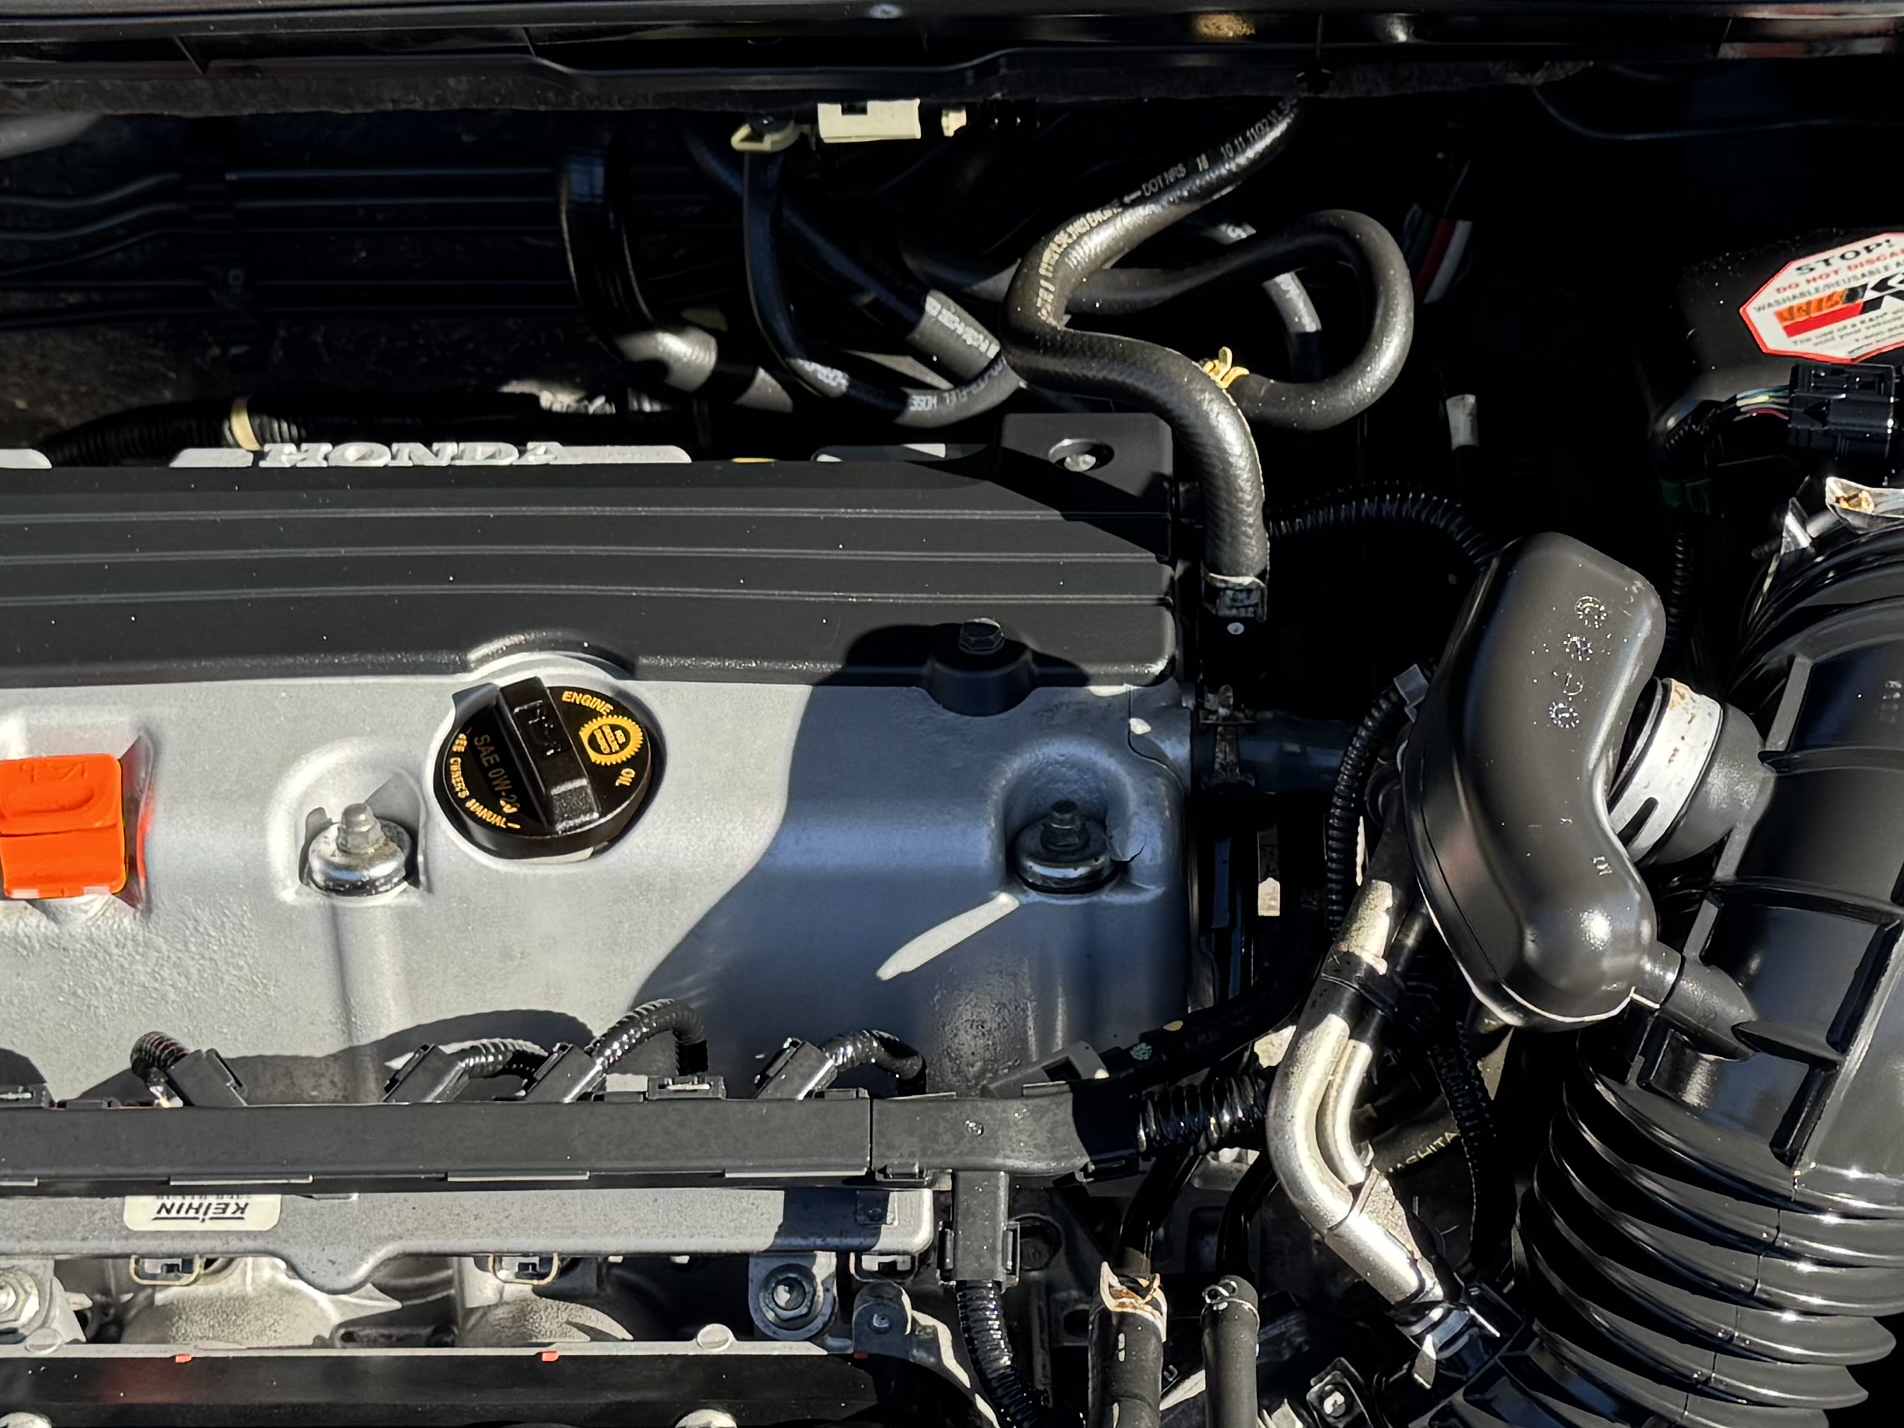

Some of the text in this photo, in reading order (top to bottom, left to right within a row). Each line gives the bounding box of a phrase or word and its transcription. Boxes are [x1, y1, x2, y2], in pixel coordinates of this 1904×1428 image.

[1795, 236, 1894, 277] STOP!
[1754, 264, 1890, 313] WASHABLE/REUSABLE
[1774, 281, 1800, 295] DO
[1804, 267, 1843, 285] NOT
[908, 394, 938, 411] HOSE
[258, 441, 575, 468] HONDA
[561, 690, 614, 716] ENGINE
[474, 734, 500, 767] SAE
[615, 767, 636, 787] OIL
